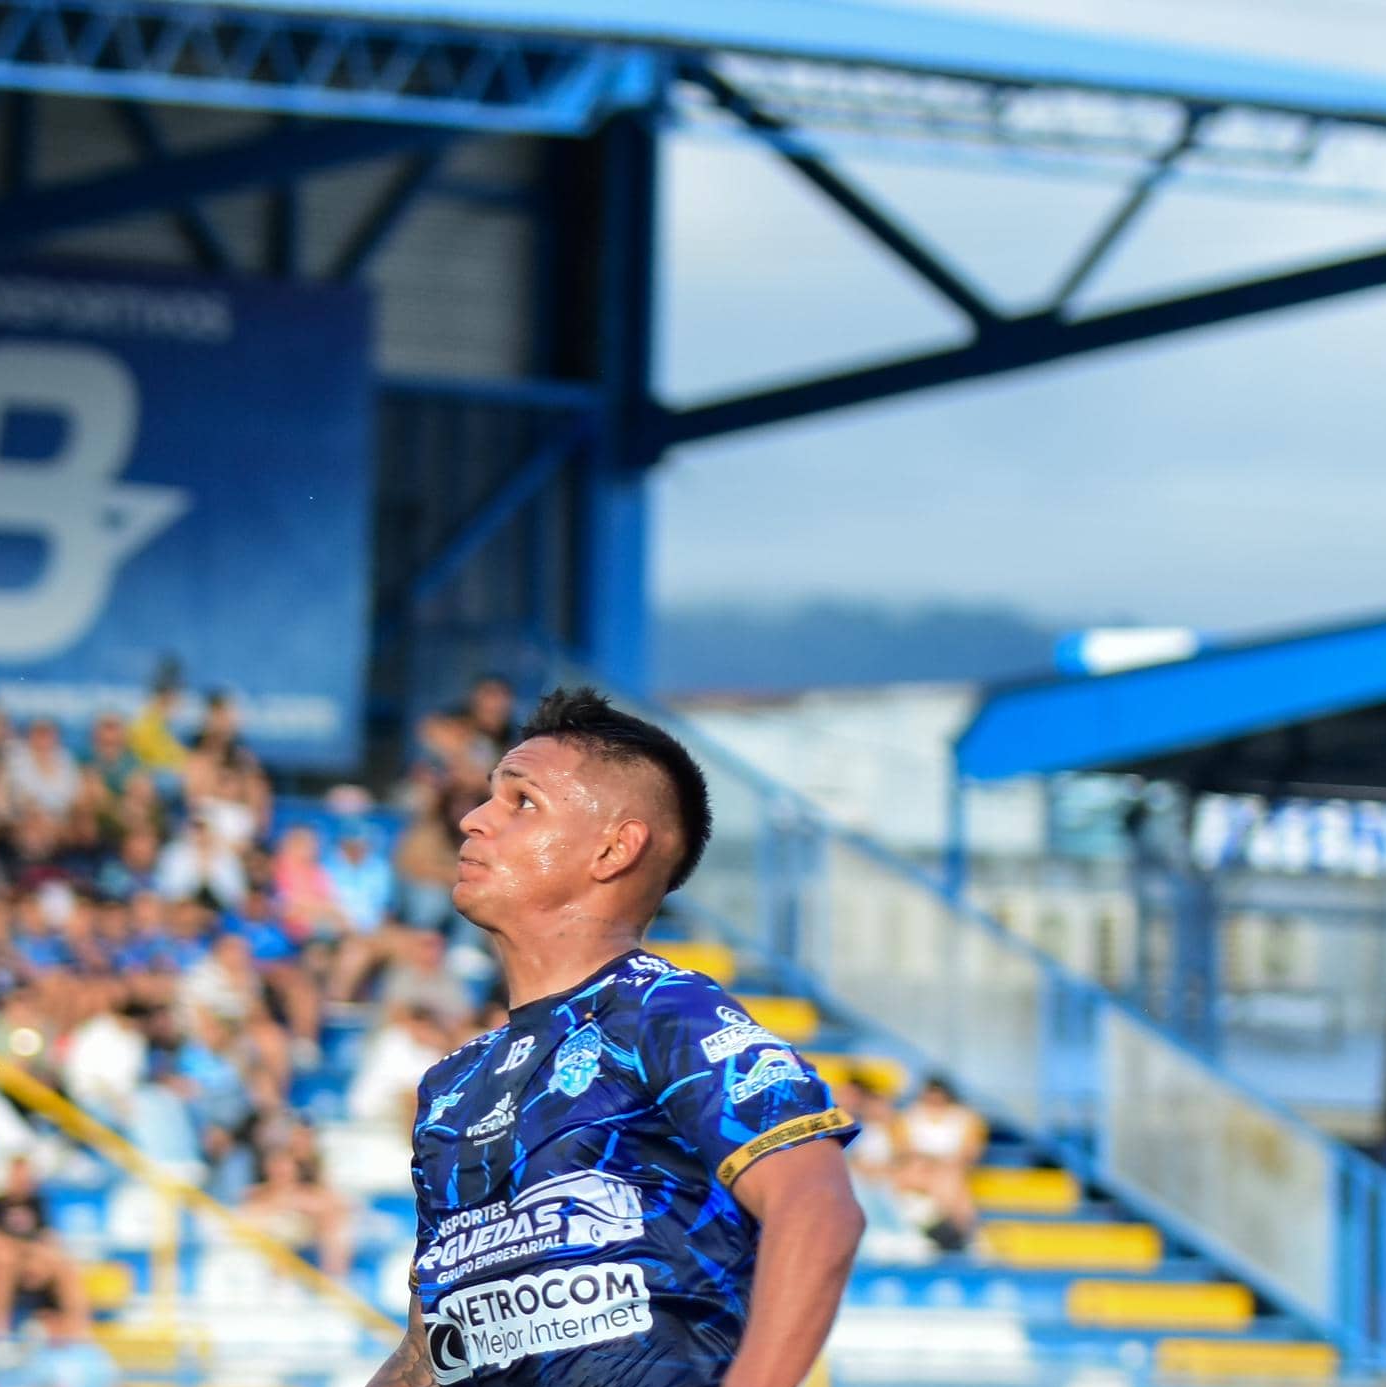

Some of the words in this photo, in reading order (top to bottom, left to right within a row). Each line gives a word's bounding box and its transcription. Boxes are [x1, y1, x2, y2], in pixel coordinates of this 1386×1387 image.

[495, 1036, 535, 1074] JB
[416, 1202, 563, 1270] RGUEDAS
[438, 1201, 508, 1238] NSPORTES
[437, 1260, 473, 1285] GRUPO
[474, 1234, 565, 1272] EMPRESARIAL
[471, 1328, 523, 1359] Mejor
[530, 1303, 643, 1346] Internet
